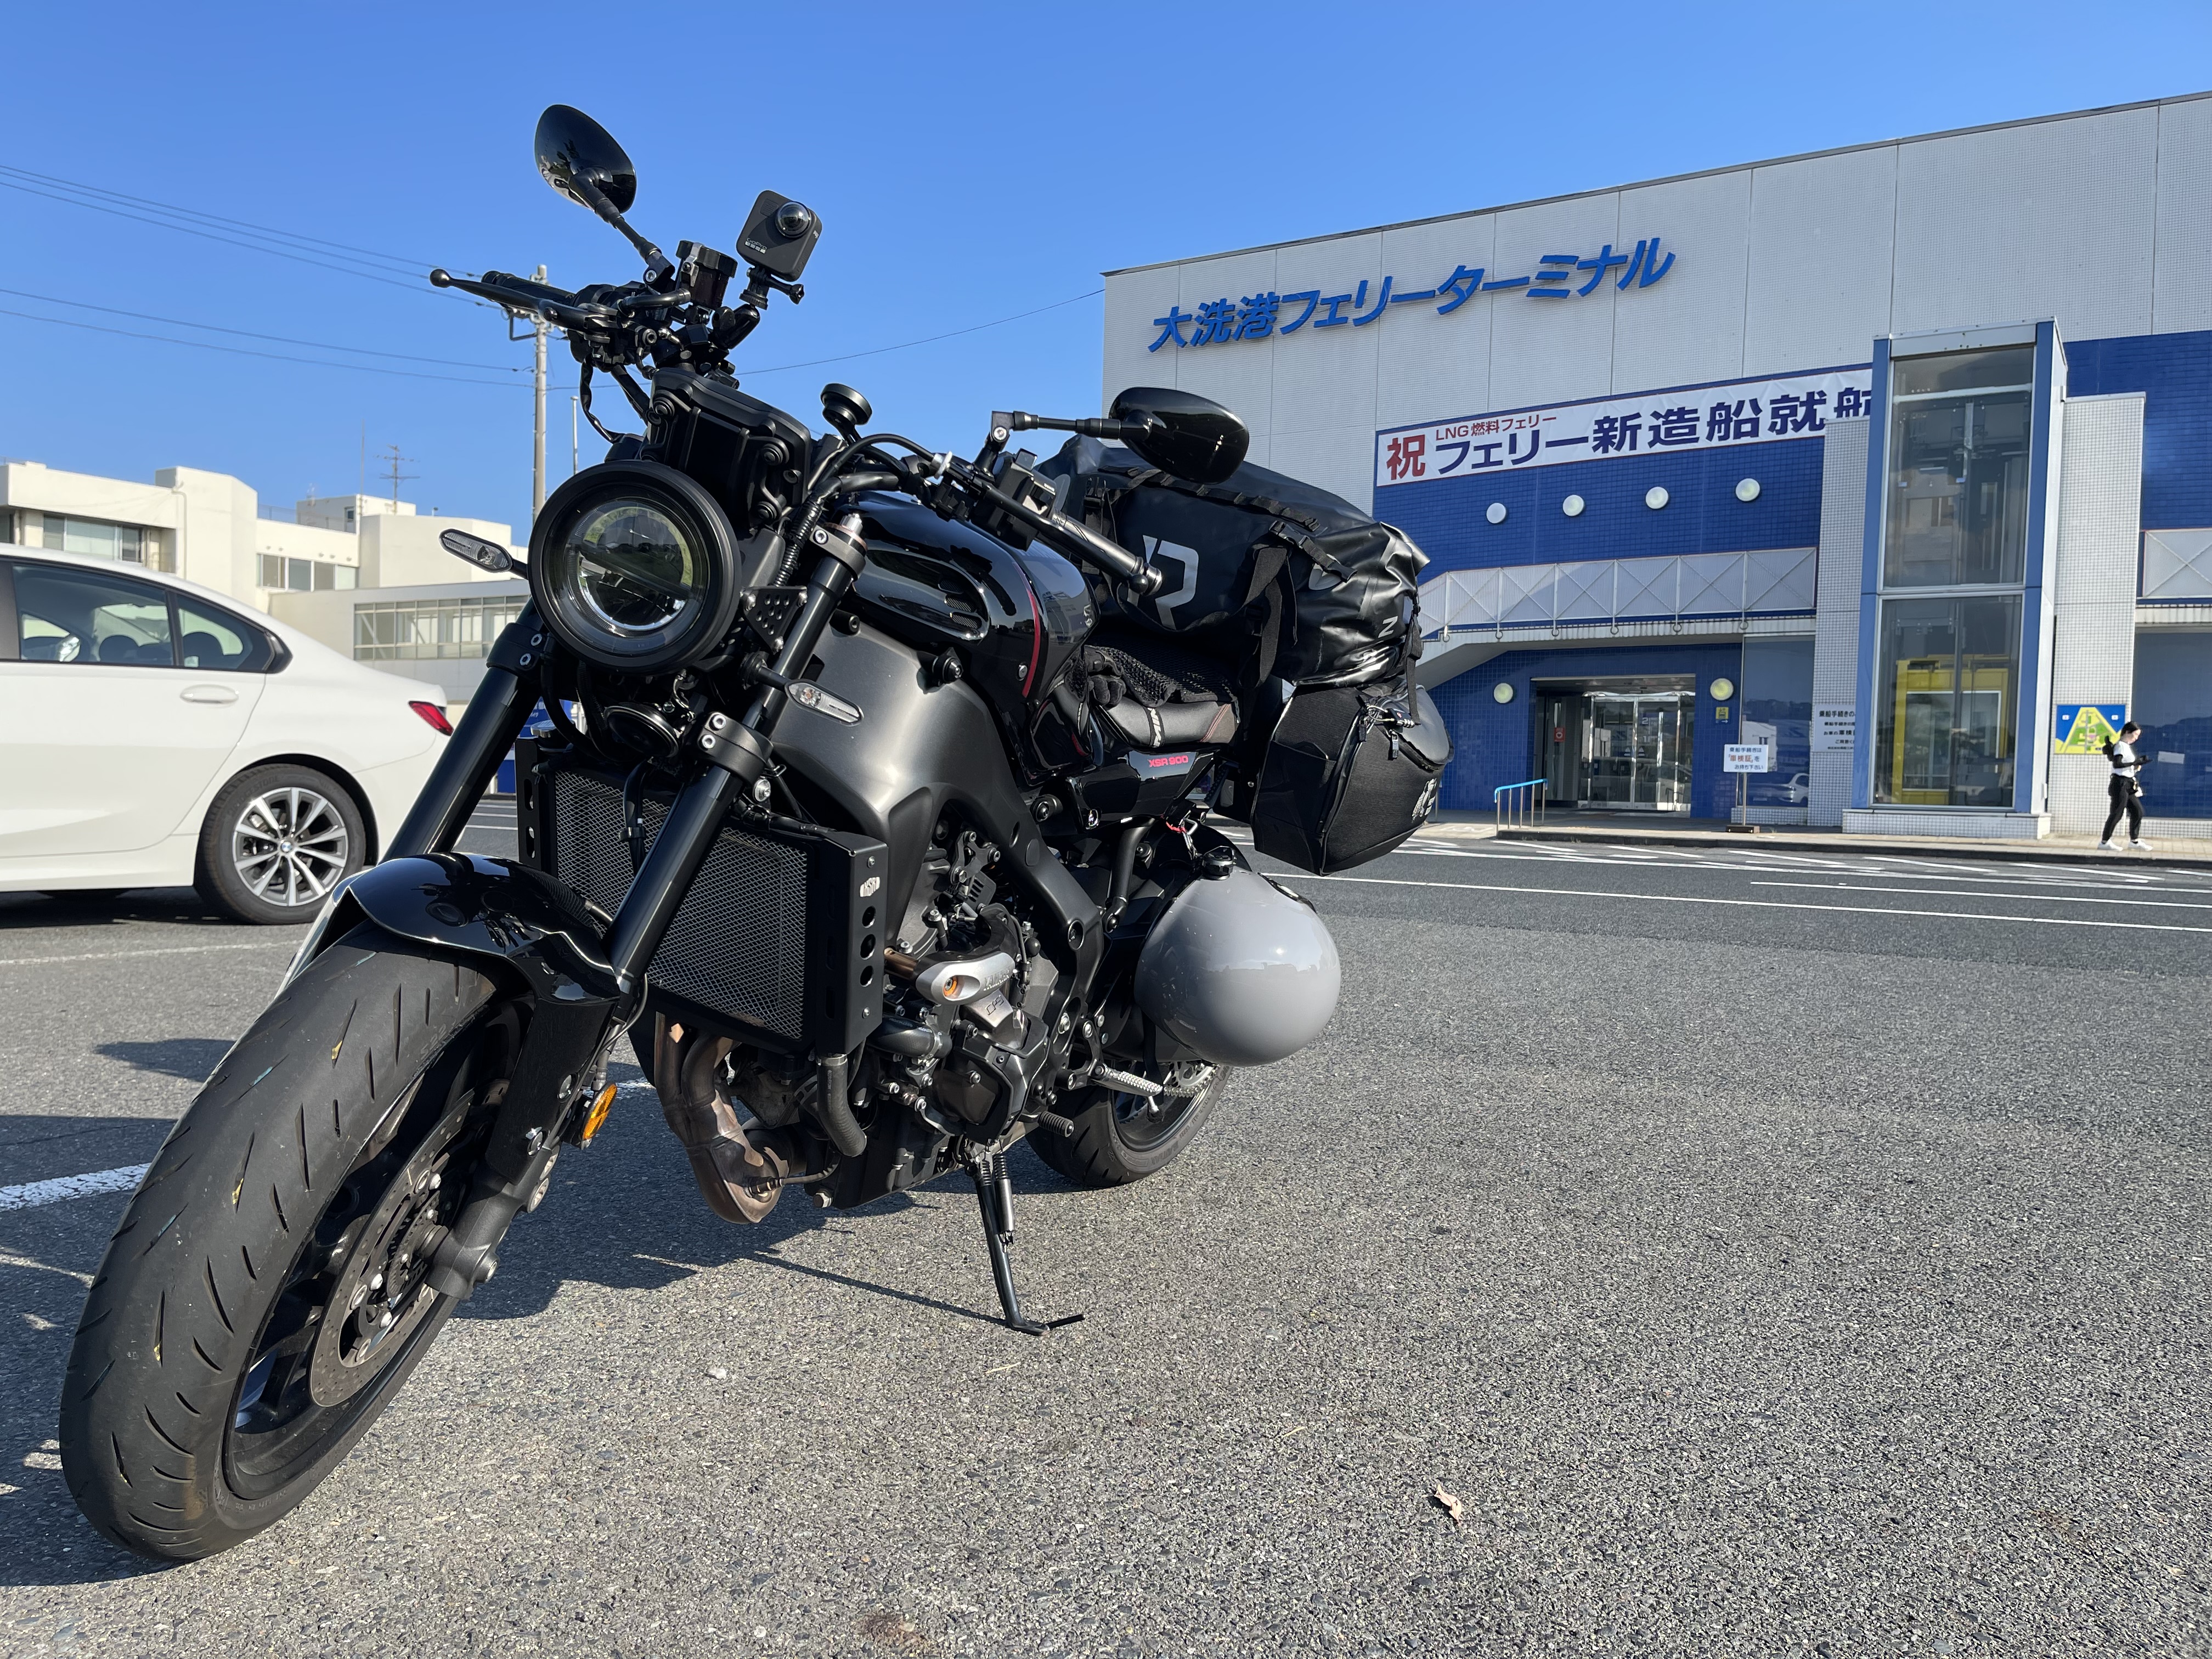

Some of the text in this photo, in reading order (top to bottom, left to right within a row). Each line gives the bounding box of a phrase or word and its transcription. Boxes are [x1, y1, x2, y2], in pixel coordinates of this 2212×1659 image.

[747, 238, 767, 250] GoPro
[1148, 238, 1675, 352] 大洗港フェリーターミナル
[1386, 434, 1425, 480] 祝
